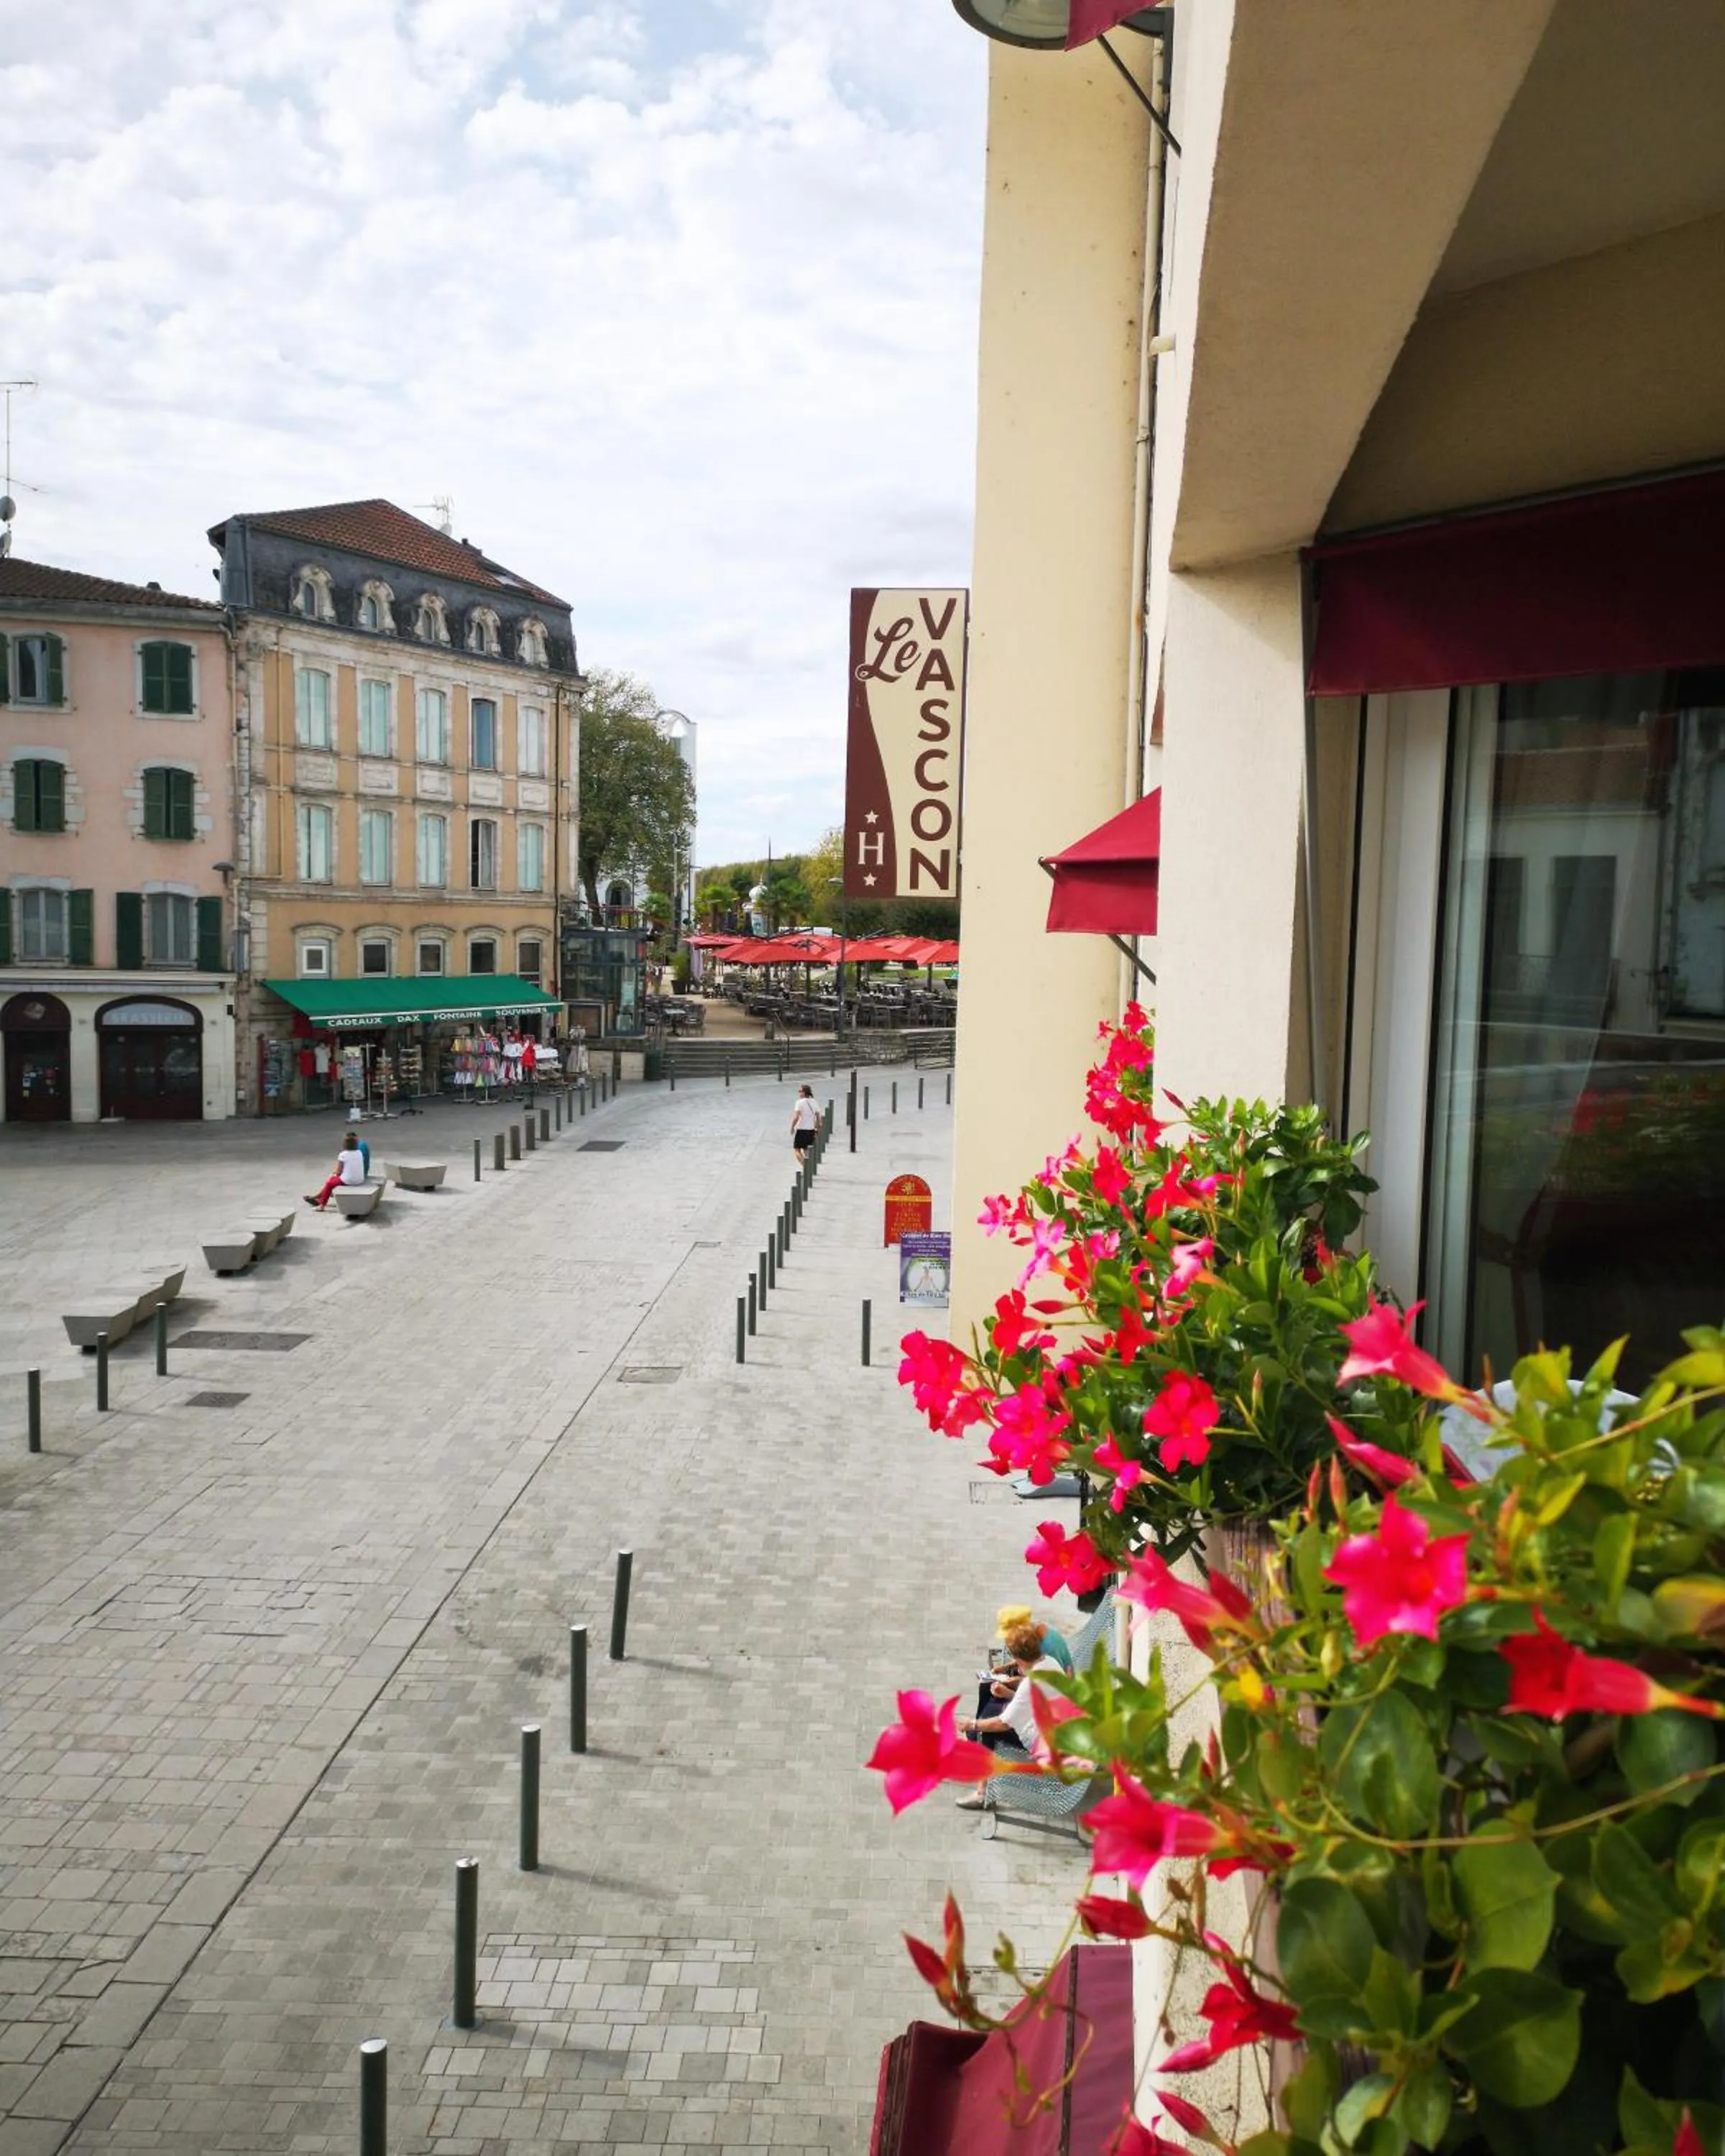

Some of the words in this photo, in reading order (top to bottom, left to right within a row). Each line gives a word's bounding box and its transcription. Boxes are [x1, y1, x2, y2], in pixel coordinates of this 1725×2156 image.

[855, 617, 922, 683] Le
[909, 597, 957, 890] VASCON
[857, 831, 885, 865] H
[328, 1017, 382, 1027] CADEAUX
[397, 1015, 420, 1023] DAX
[433, 1011, 482, 1021] FONTAINE
